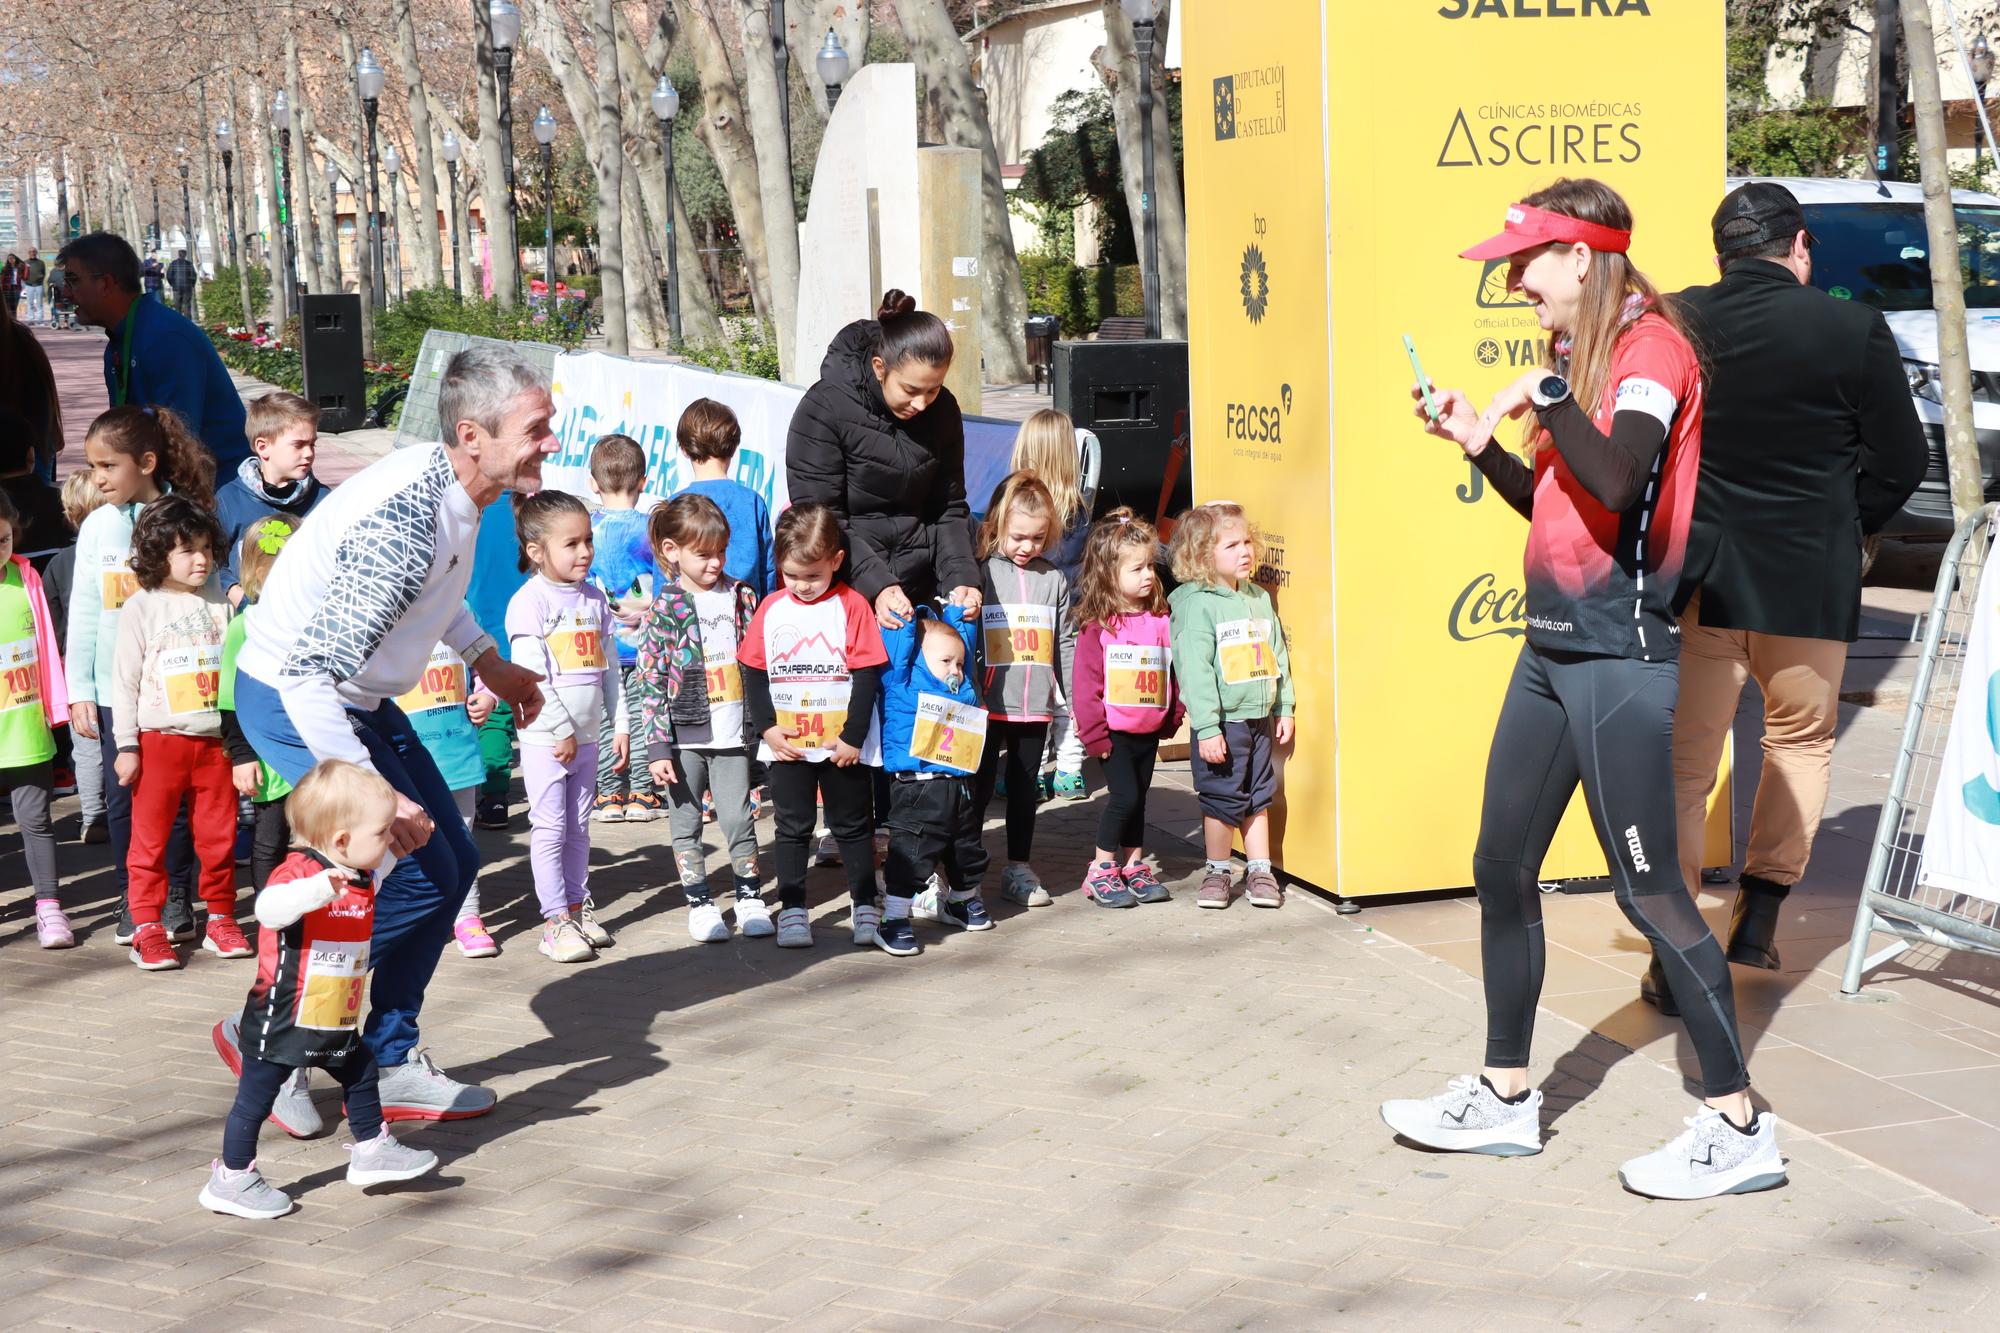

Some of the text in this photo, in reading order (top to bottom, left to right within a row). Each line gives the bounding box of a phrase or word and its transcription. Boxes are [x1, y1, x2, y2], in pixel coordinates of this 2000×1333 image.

[1234, 61, 1281, 90] DIPUTACIÓ
[1478, 100, 1642, 119] CLÍNICAS BIOMÉDICAS
[1236, 110, 1283, 139] CASTELLÓ
[1253, 213, 1267, 238] bp
[1473, 318, 1509, 329] Official
[1227, 403, 1281, 444] Facsa
[574, 632, 595, 656] 97
[1013, 629, 1039, 651] 80
[431, 651, 449, 662] arató
[420, 667, 455, 695] 102
[1135, 670, 1158, 694] 48
[796, 712, 824, 737] 54
[940, 727, 954, 752] 2
[936, 753, 952, 764] LUCAS
[347, 977, 362, 1011] 3
